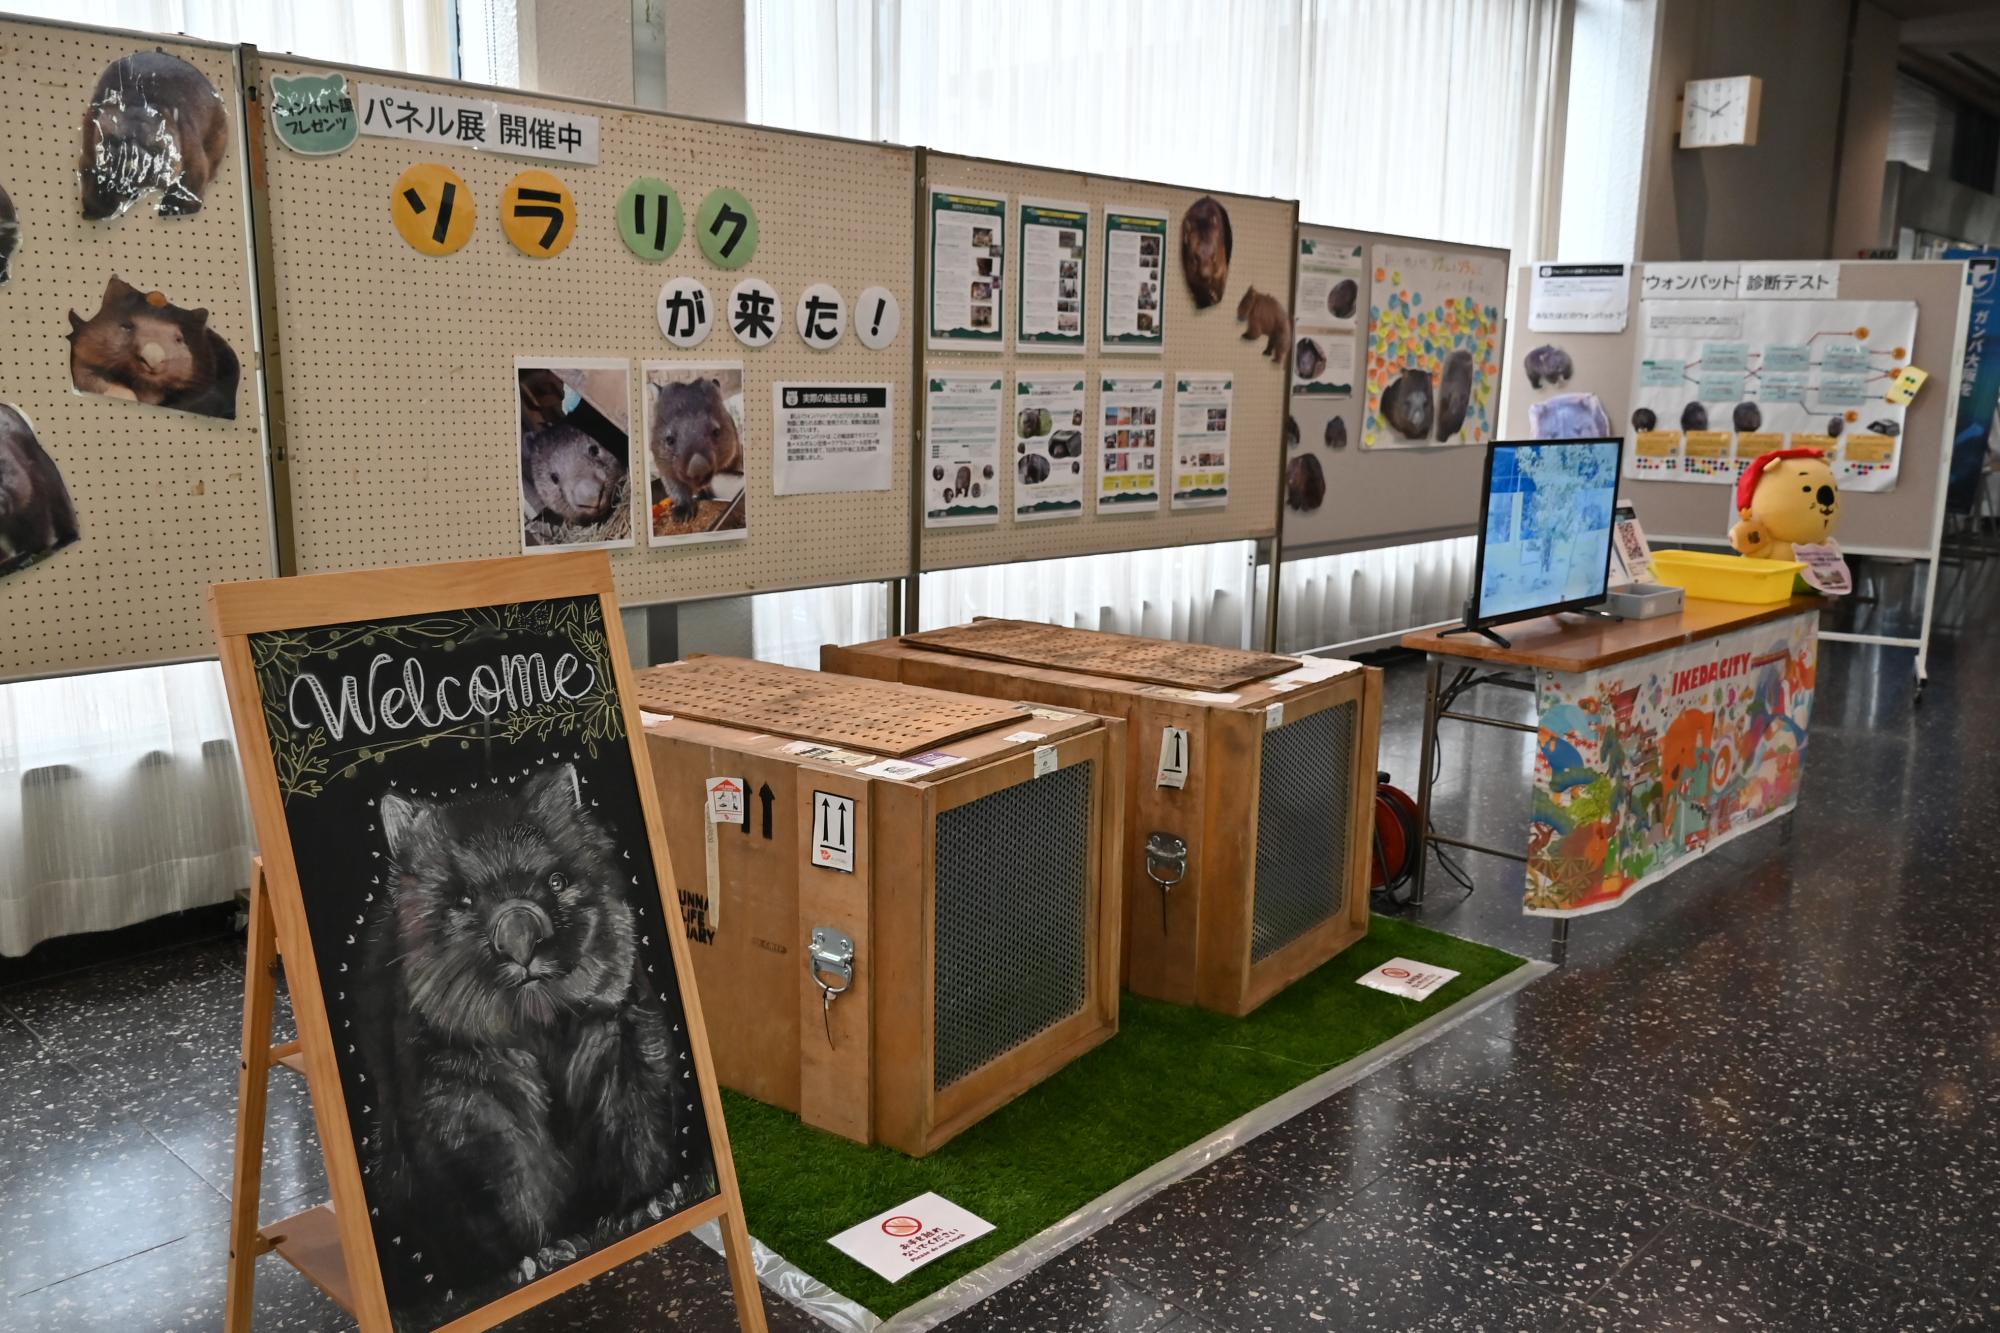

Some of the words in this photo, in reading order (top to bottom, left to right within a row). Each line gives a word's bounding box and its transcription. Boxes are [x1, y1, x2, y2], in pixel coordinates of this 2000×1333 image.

[364, 97, 486, 143] パネル展
[500, 113, 583, 154] 開催中
[1645, 274, 1736, 291] ウォンバット
[1746, 274, 1830, 292] 診断テスト
[1719, 651, 1752, 680] CITY
[289, 652, 596, 741] Welcome
[902, 1228, 960, 1257] ないでください
